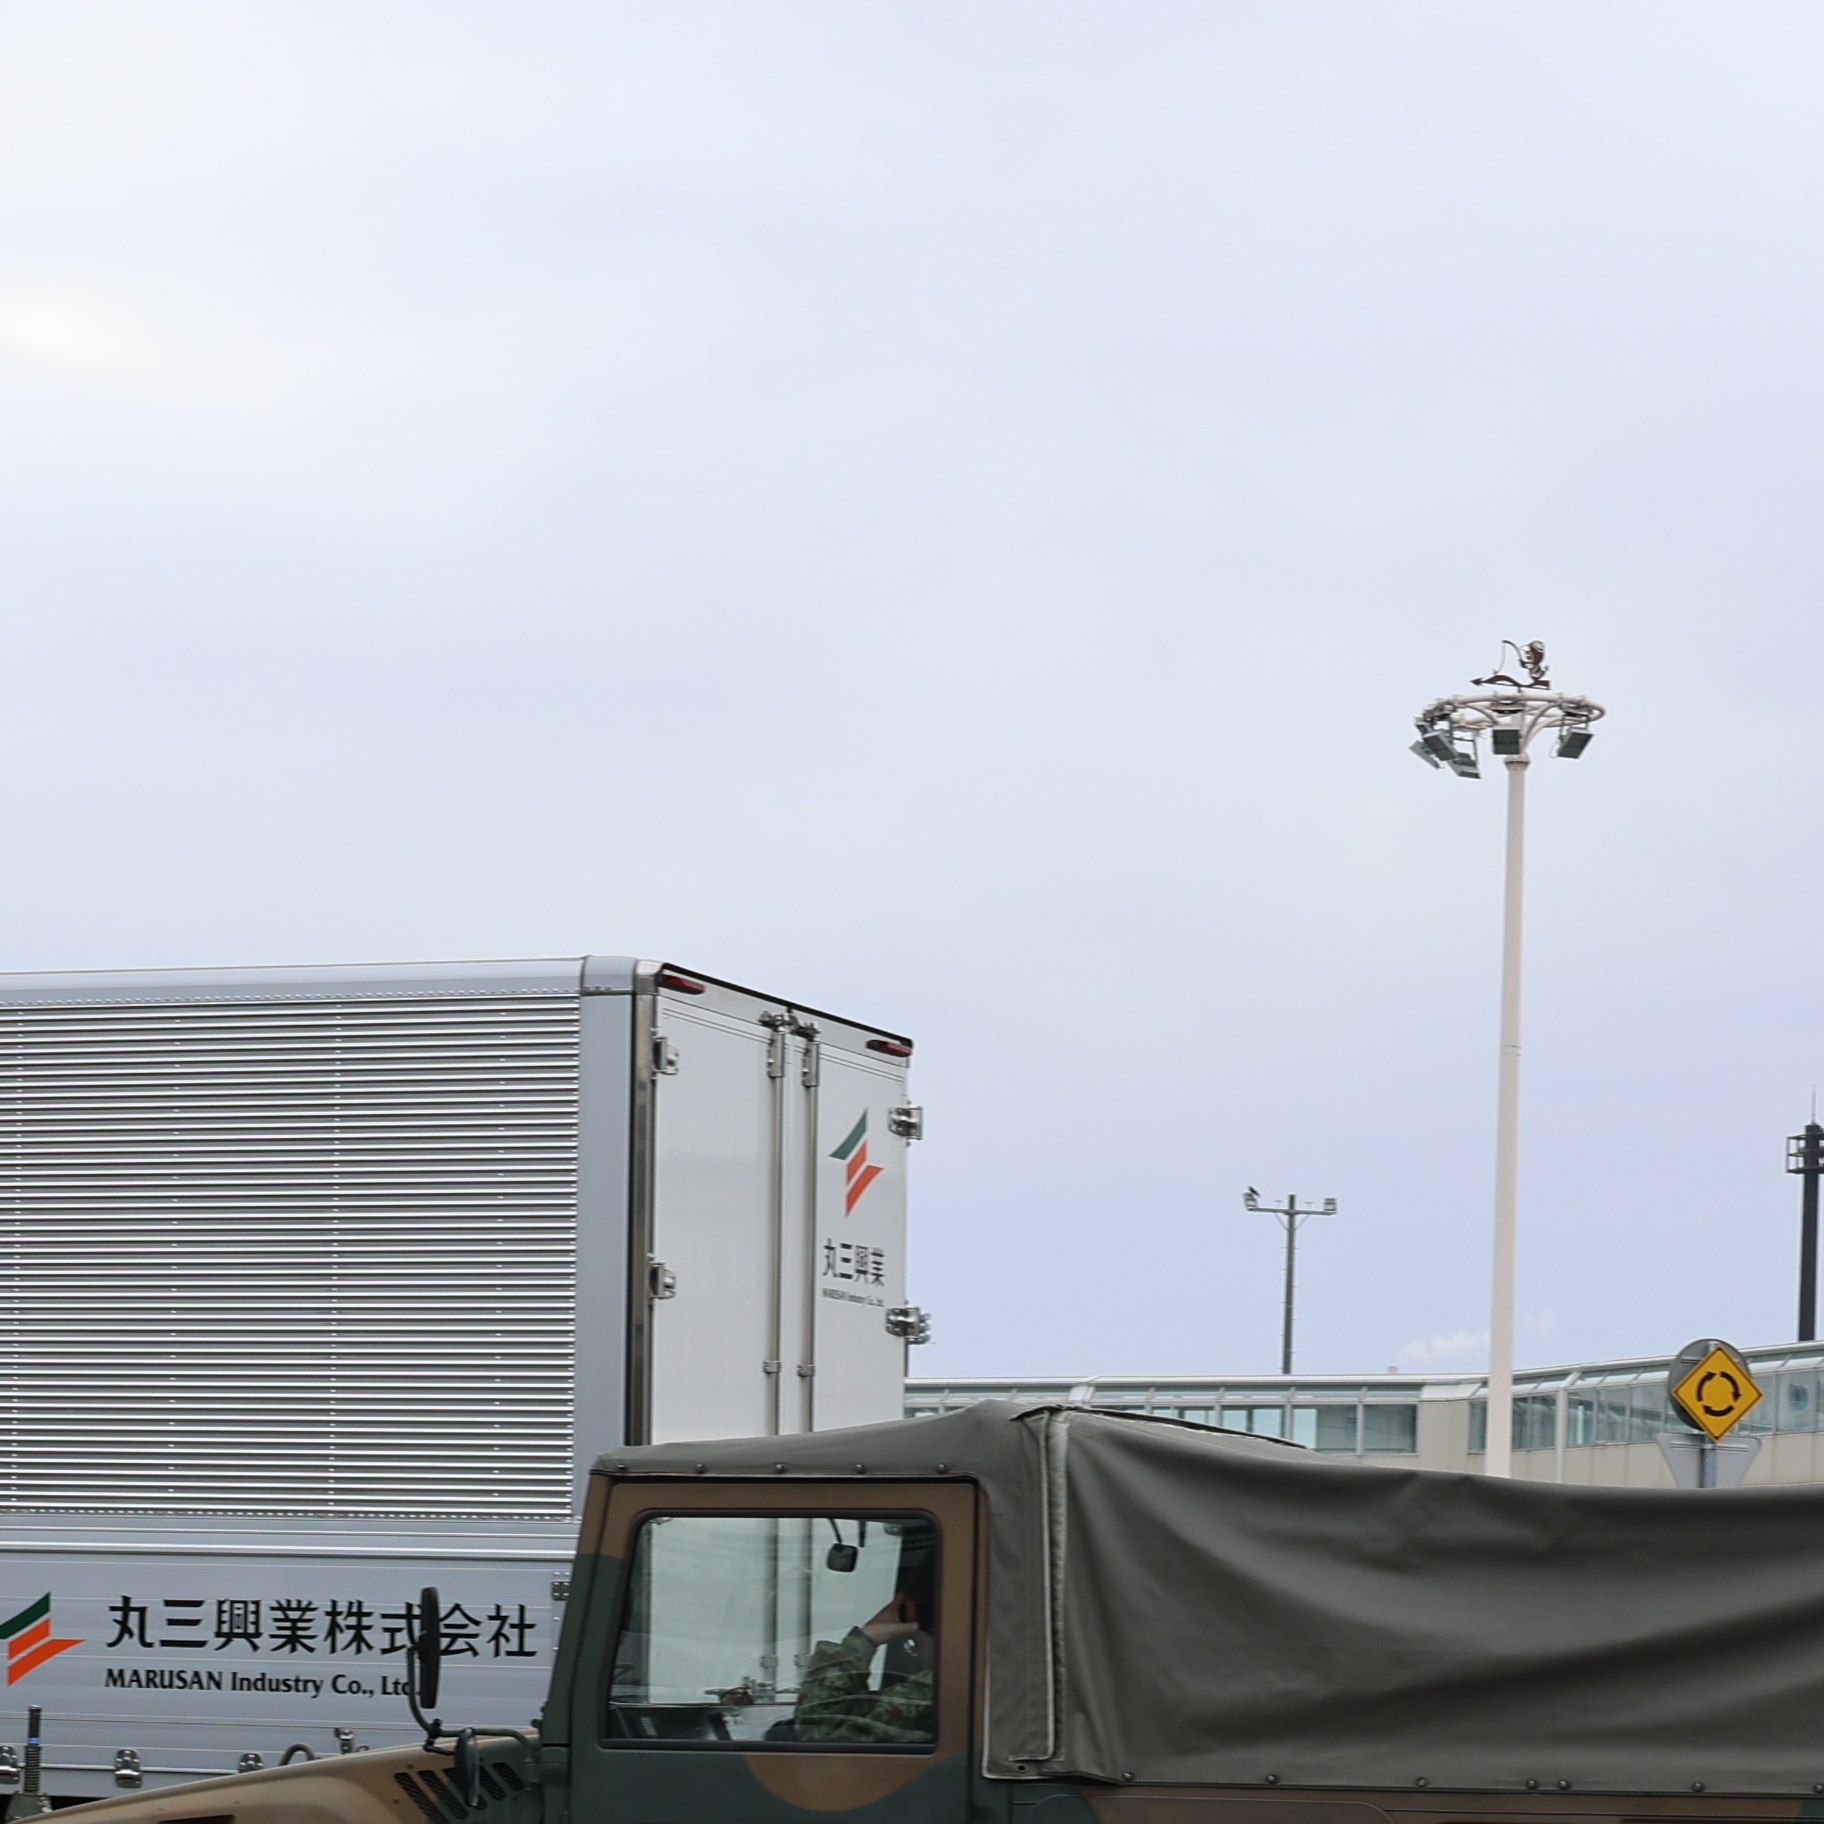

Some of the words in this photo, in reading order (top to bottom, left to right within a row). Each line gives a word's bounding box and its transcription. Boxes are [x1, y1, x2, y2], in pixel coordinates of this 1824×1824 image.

[822, 1238, 886, 1287] 丸三興業
[106, 1595, 538, 1658] 丸三興業株式会社
[105, 1668, 223, 1691] MARUSAN
[231, 1672, 324, 1699] Industry
[331, 1674, 374, 1698] Co.,
